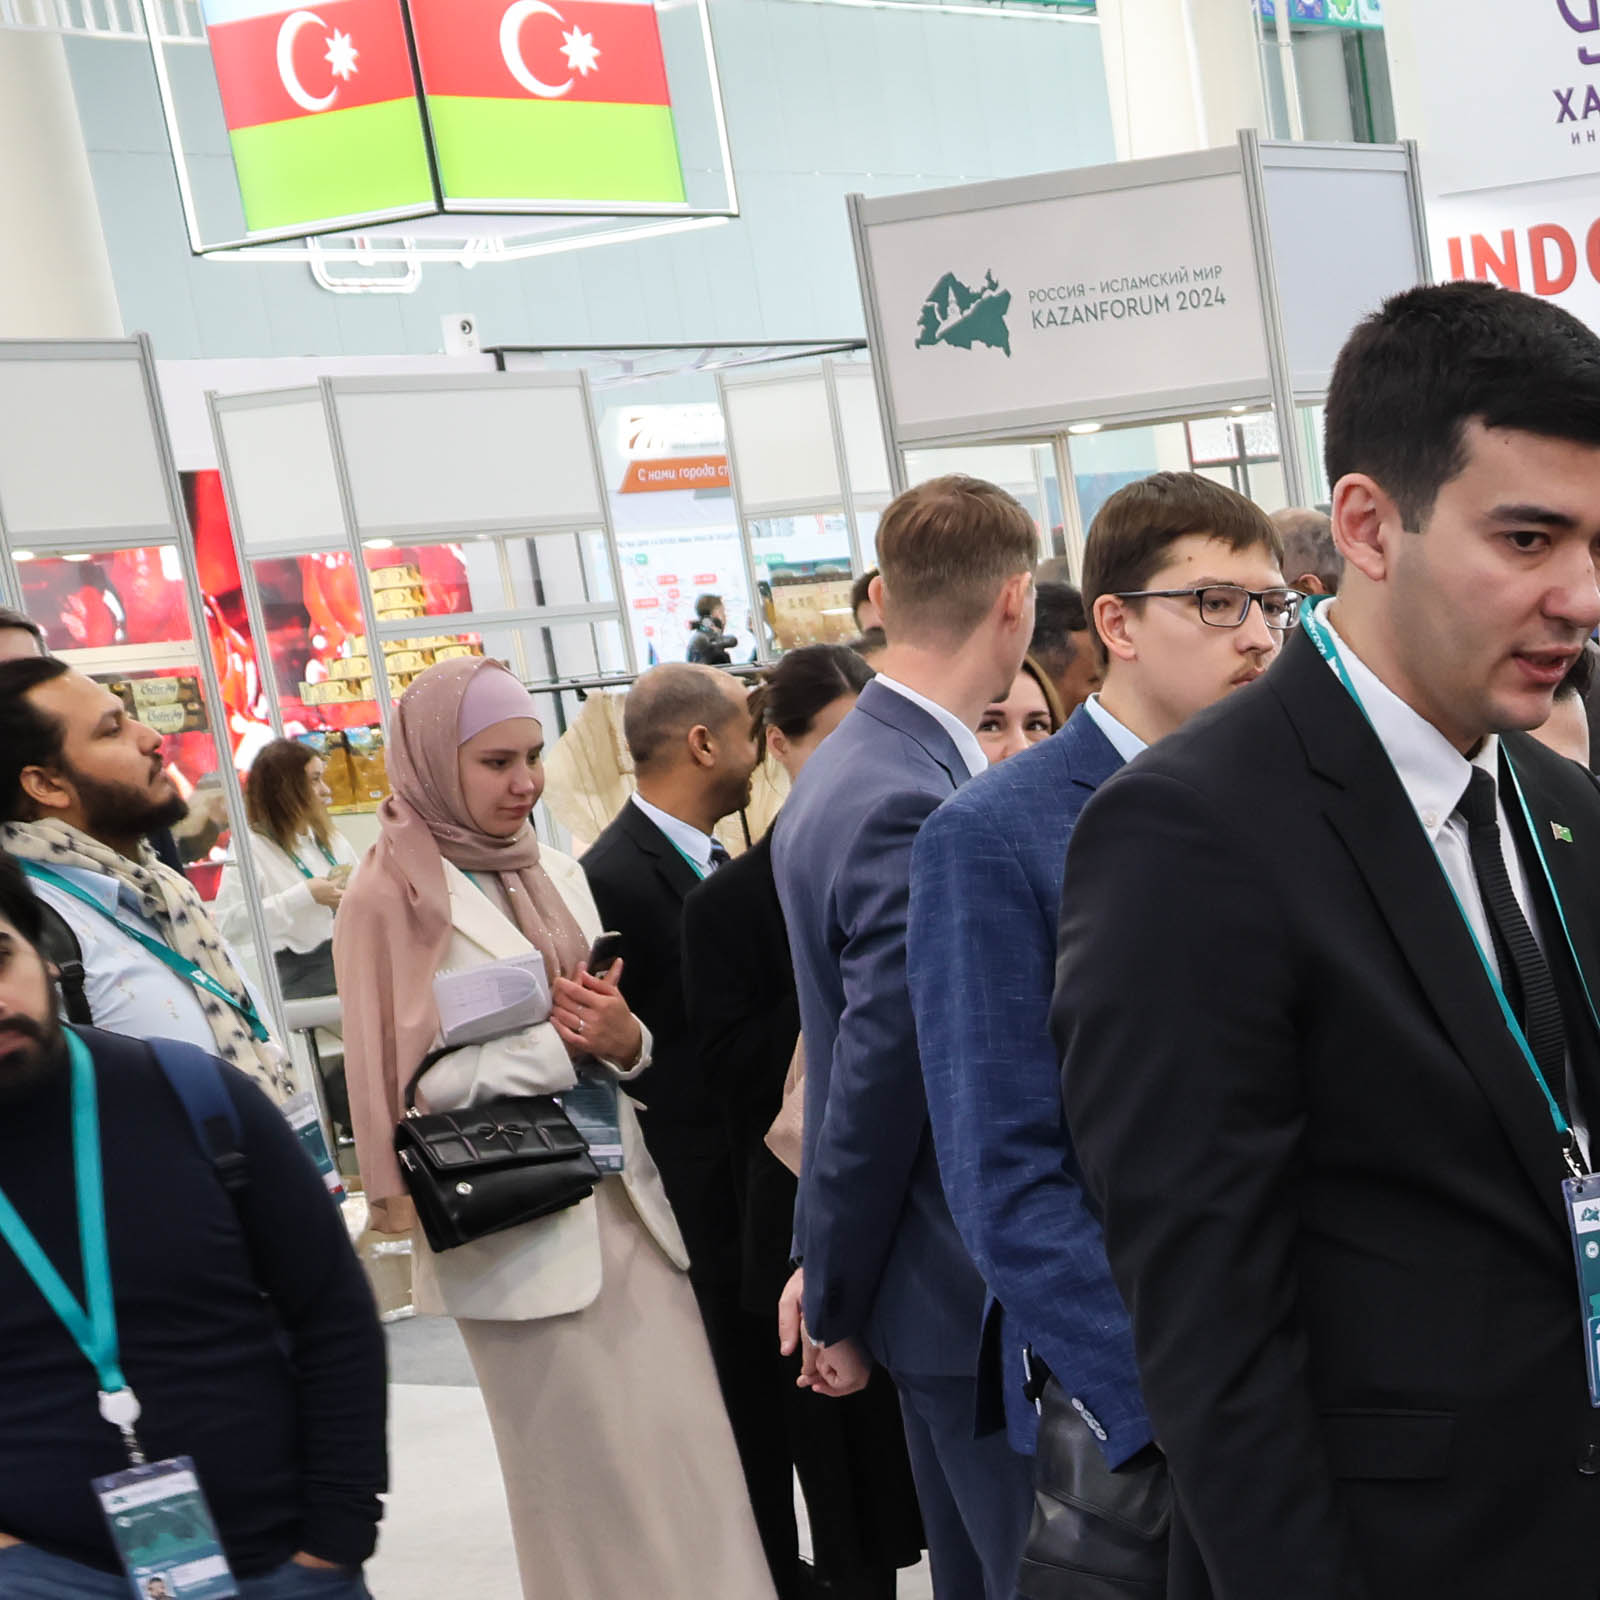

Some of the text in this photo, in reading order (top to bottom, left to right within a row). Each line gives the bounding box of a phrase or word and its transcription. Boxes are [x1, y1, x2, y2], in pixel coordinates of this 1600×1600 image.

[1029, 283, 1086, 303] РОССИЯ
[1100, 266, 1189, 294] ИСЛАМСКИЙ
[1193, 265, 1222, 281] МИР
[1031, 286, 1226, 329] KAZANFORUM 2024
[638, 468, 647, 481] С
[648, 467, 675, 482] нами
[679, 463, 716, 480] города
